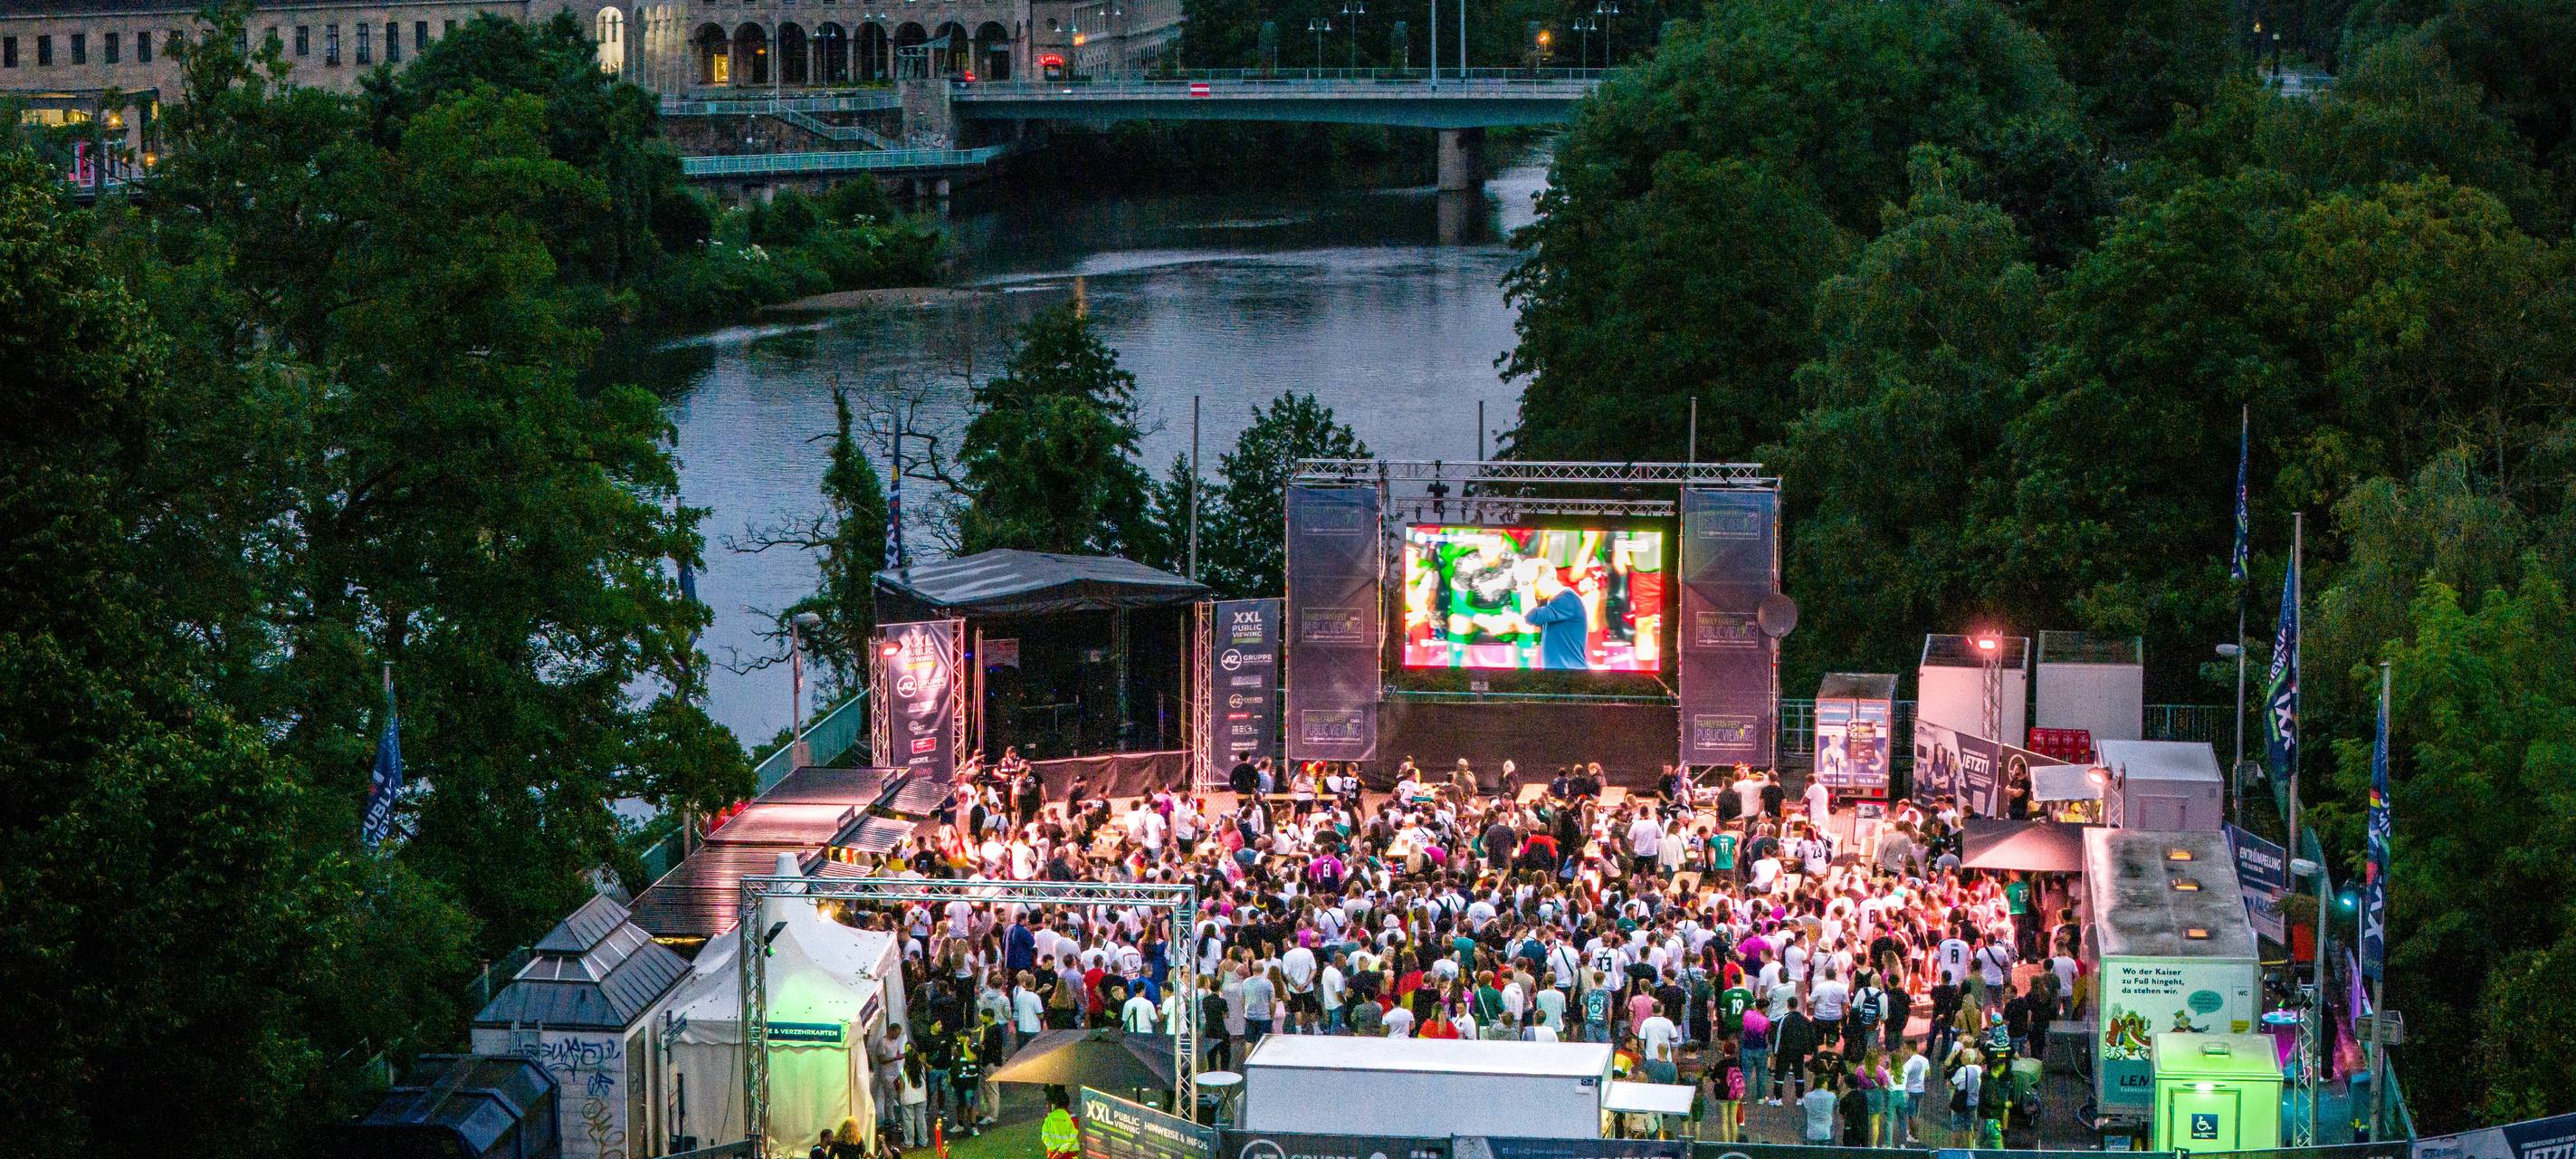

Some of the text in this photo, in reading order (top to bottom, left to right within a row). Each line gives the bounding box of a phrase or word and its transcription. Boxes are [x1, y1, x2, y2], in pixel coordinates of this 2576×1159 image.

[1233, 611, 1262, 623] XXL
[1232, 624, 1263, 632] PUBLIC
[903, 635, 934, 647] XXL
[905, 647, 934, 656] PUBLIC
[905, 656, 934, 664] VIEWING
[1225, 655, 1238, 664] AZ
[902, 681, 914, 691] AZ
[917, 677, 947, 686] GRUPPE
[1961, 752, 1990, 775] JETZT!
[1812, 848, 1822, 858] 23
[2151, 978, 2185, 986] hingeht,
[1731, 999, 1744, 1015] 19
[780, 1029, 838, 1037] VERZEHRKARTEN
[1086, 1101, 1114, 1125] XXL
[1113, 1109, 1140, 1127] PUBLIC
[1114, 1119, 1140, 1135] VIEWING
[1143, 1121, 1179, 1142] HINWEISE
[1179, 1134, 1186, 1143] &
[1186, 1136, 1209, 1151] INFOS
